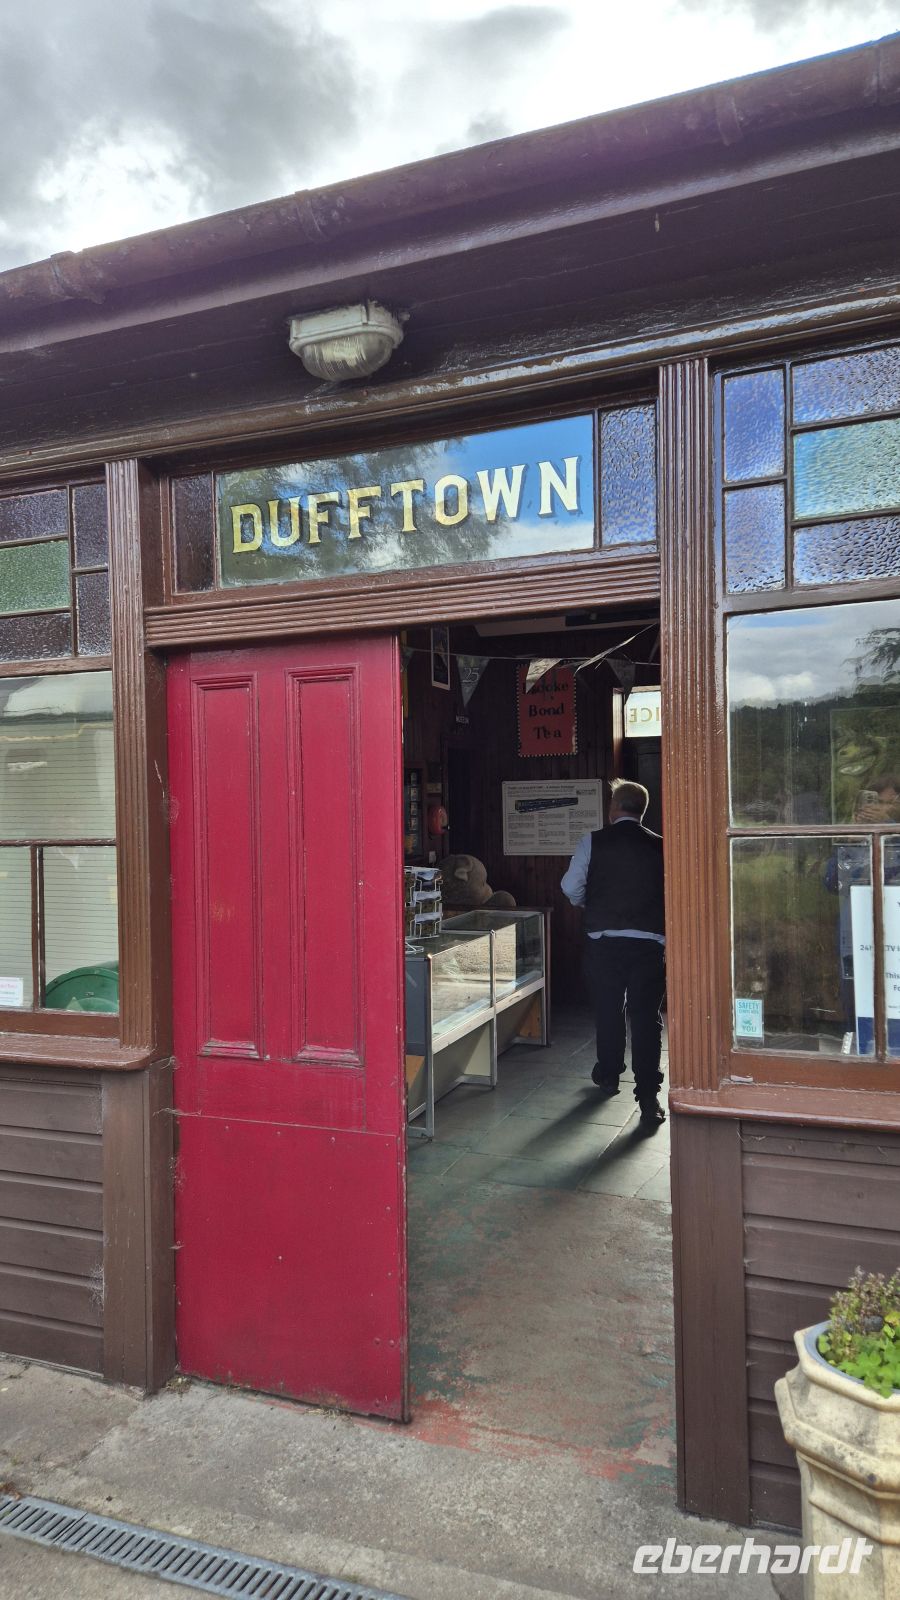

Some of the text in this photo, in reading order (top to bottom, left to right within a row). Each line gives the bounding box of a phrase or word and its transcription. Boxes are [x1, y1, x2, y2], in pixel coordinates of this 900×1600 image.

[230, 456, 581, 554] DUFFTOWN
[522, 678, 569, 695] ooke
[528, 704, 565, 718] Bond
[742, 1025, 757, 1033] YOU
